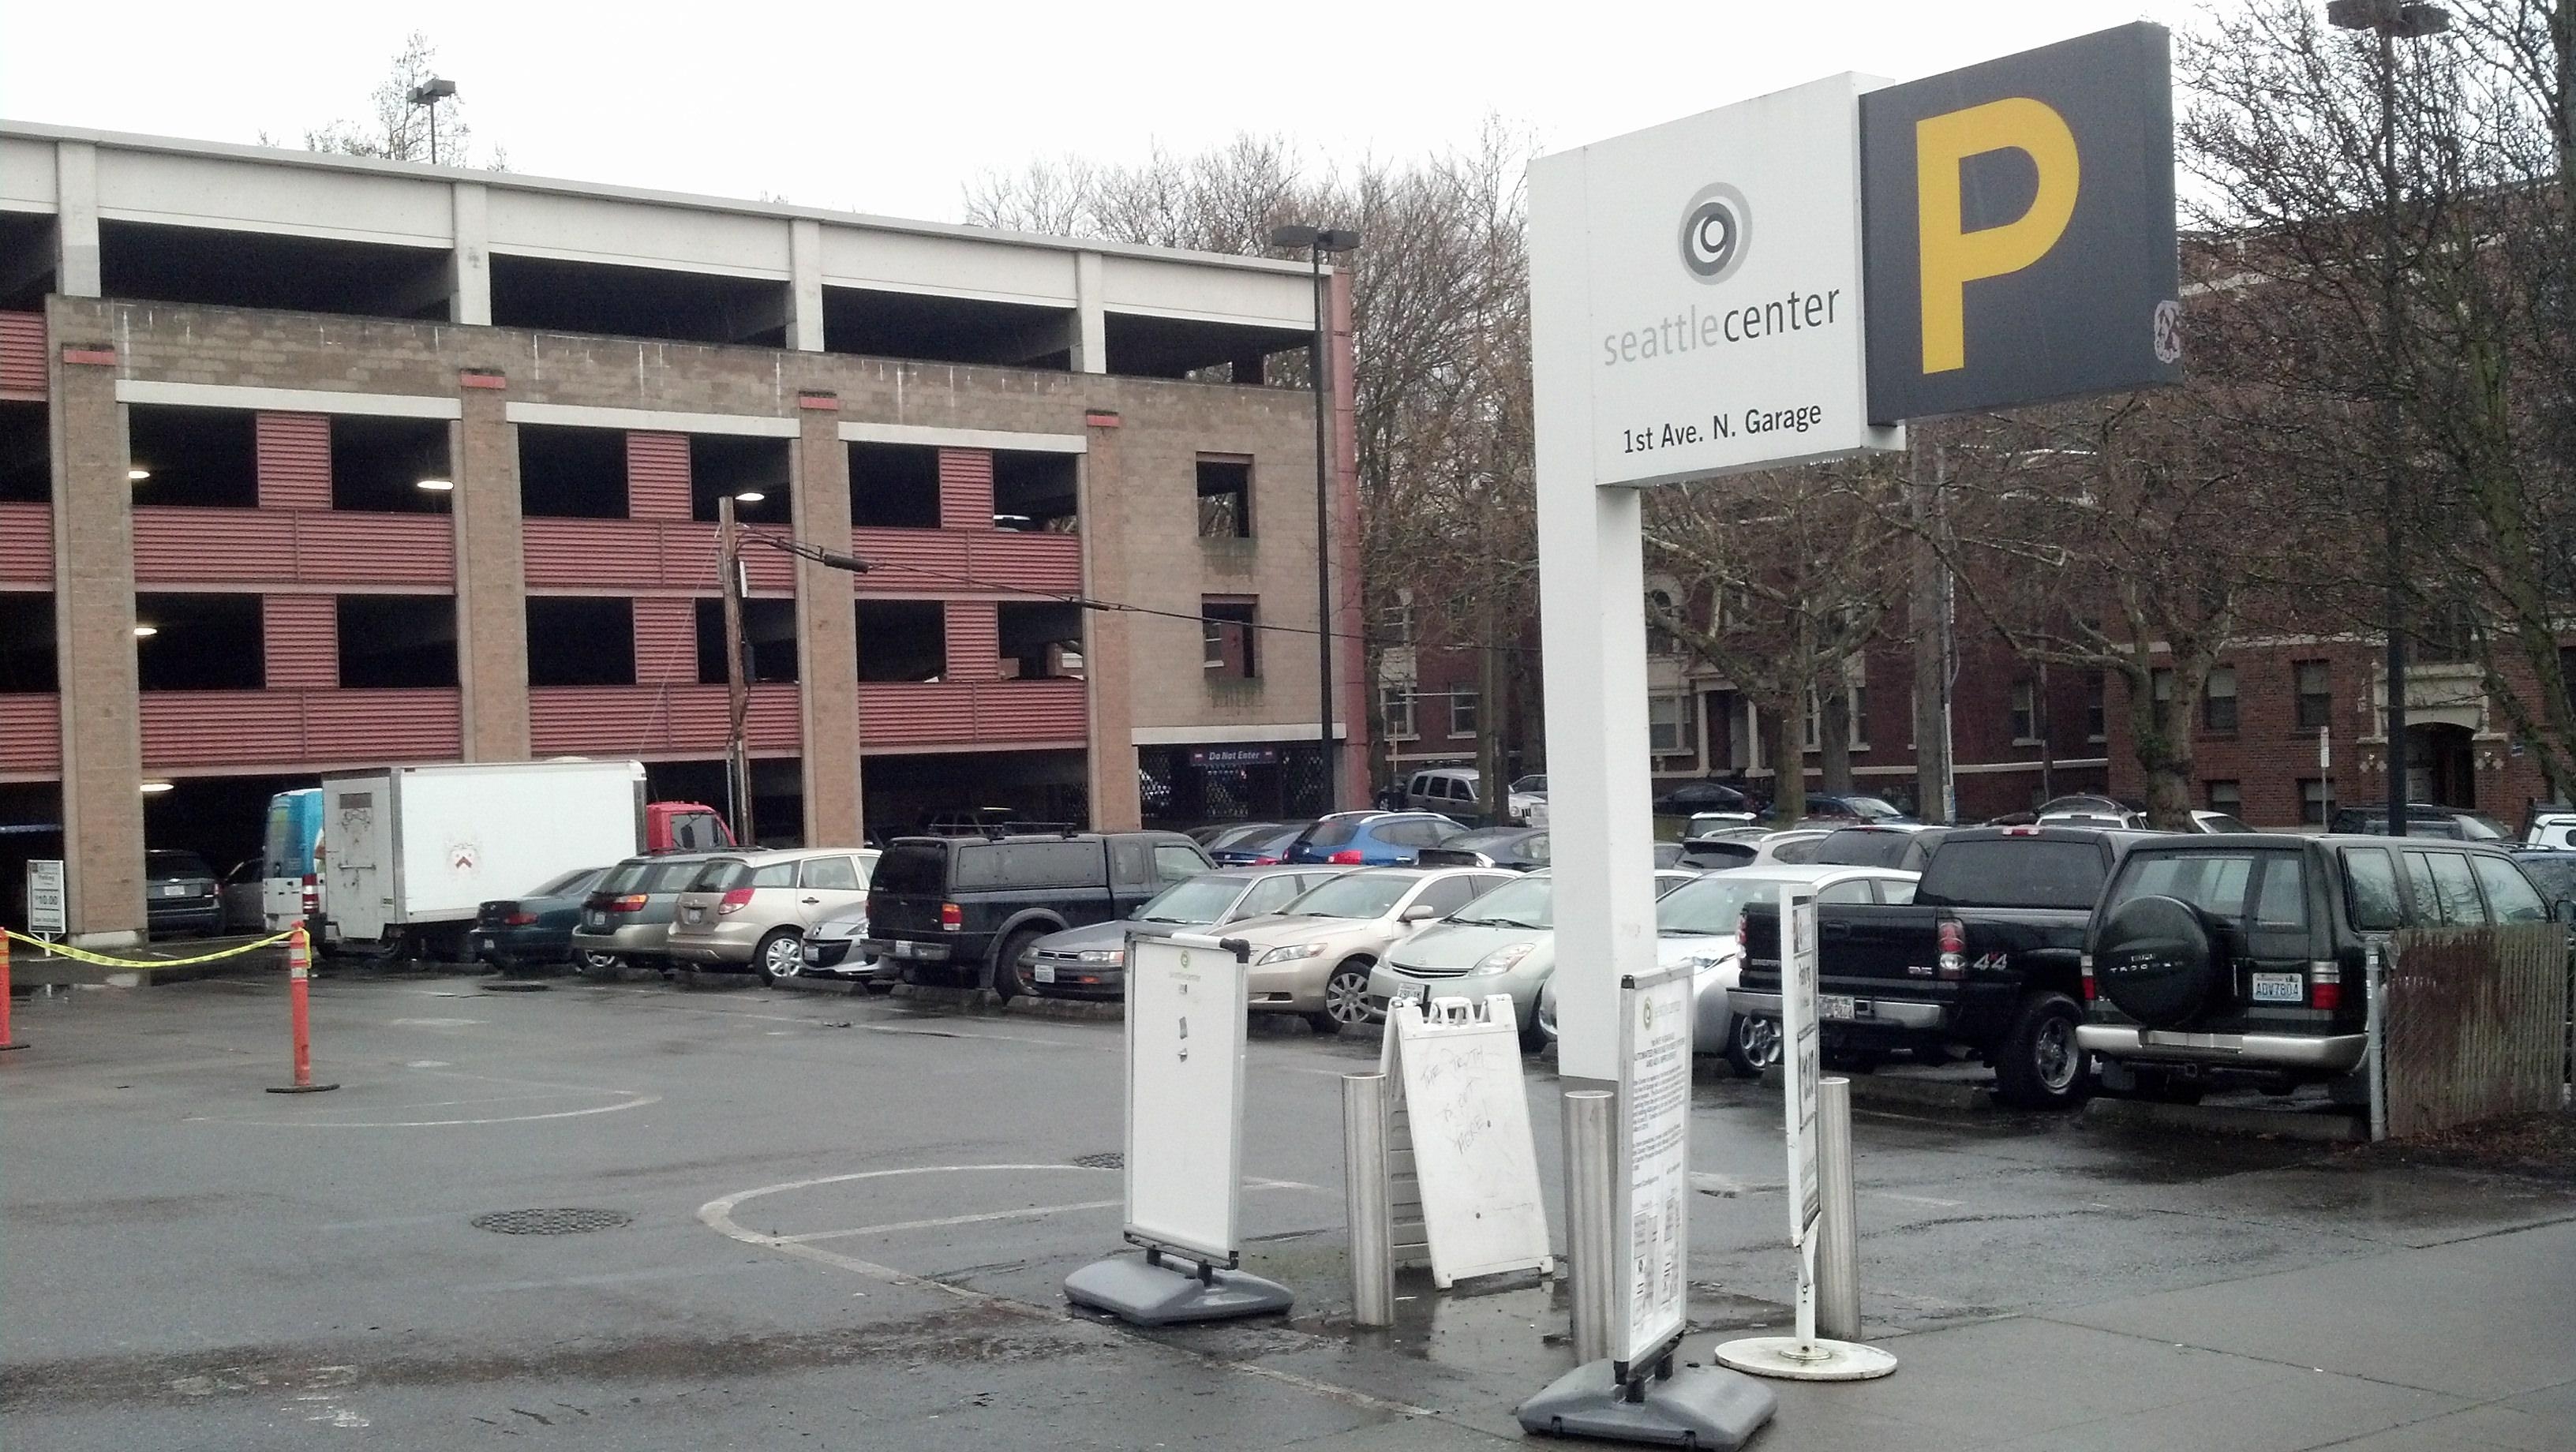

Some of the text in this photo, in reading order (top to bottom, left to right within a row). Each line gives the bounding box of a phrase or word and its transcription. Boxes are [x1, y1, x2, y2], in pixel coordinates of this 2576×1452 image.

[1916, 97, 2080, 375] P
[1623, 402, 1822, 455] 1st Ave. N. Garage
[1209, 750, 1260, 761] Do Not Enter
